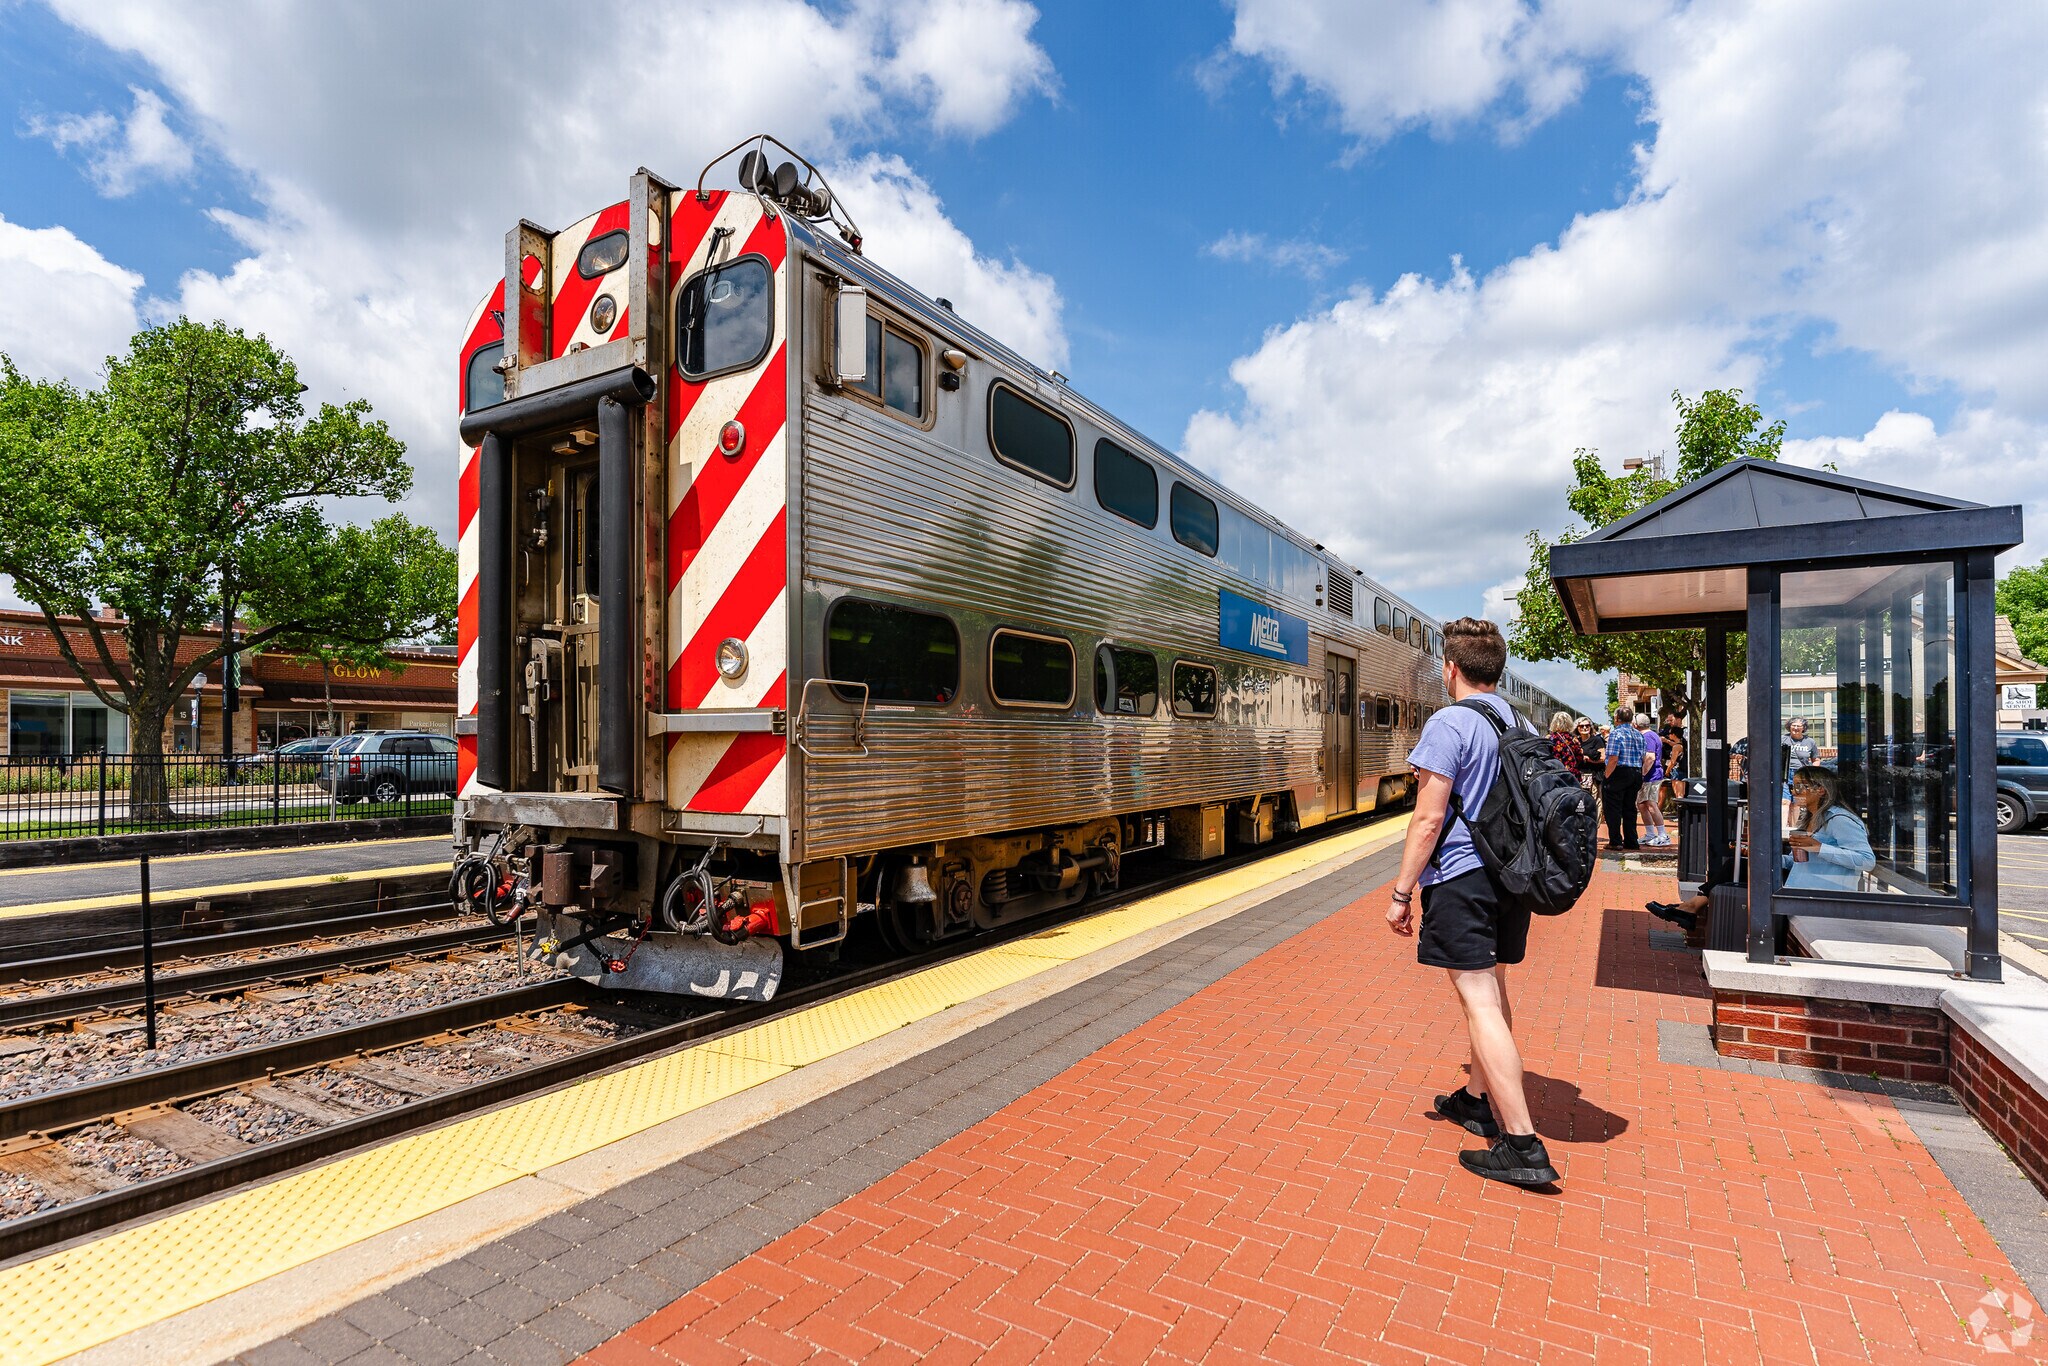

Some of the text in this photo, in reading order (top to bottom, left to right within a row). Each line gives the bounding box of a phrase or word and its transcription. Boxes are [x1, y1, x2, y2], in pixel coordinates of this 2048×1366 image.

[1250, 612, 1280, 647] Metra
[333, 664, 382, 679] GLOW
[180, 711, 187, 719] 15
[409, 719, 430, 727] Parker
[792, 829, 799, 850] F
